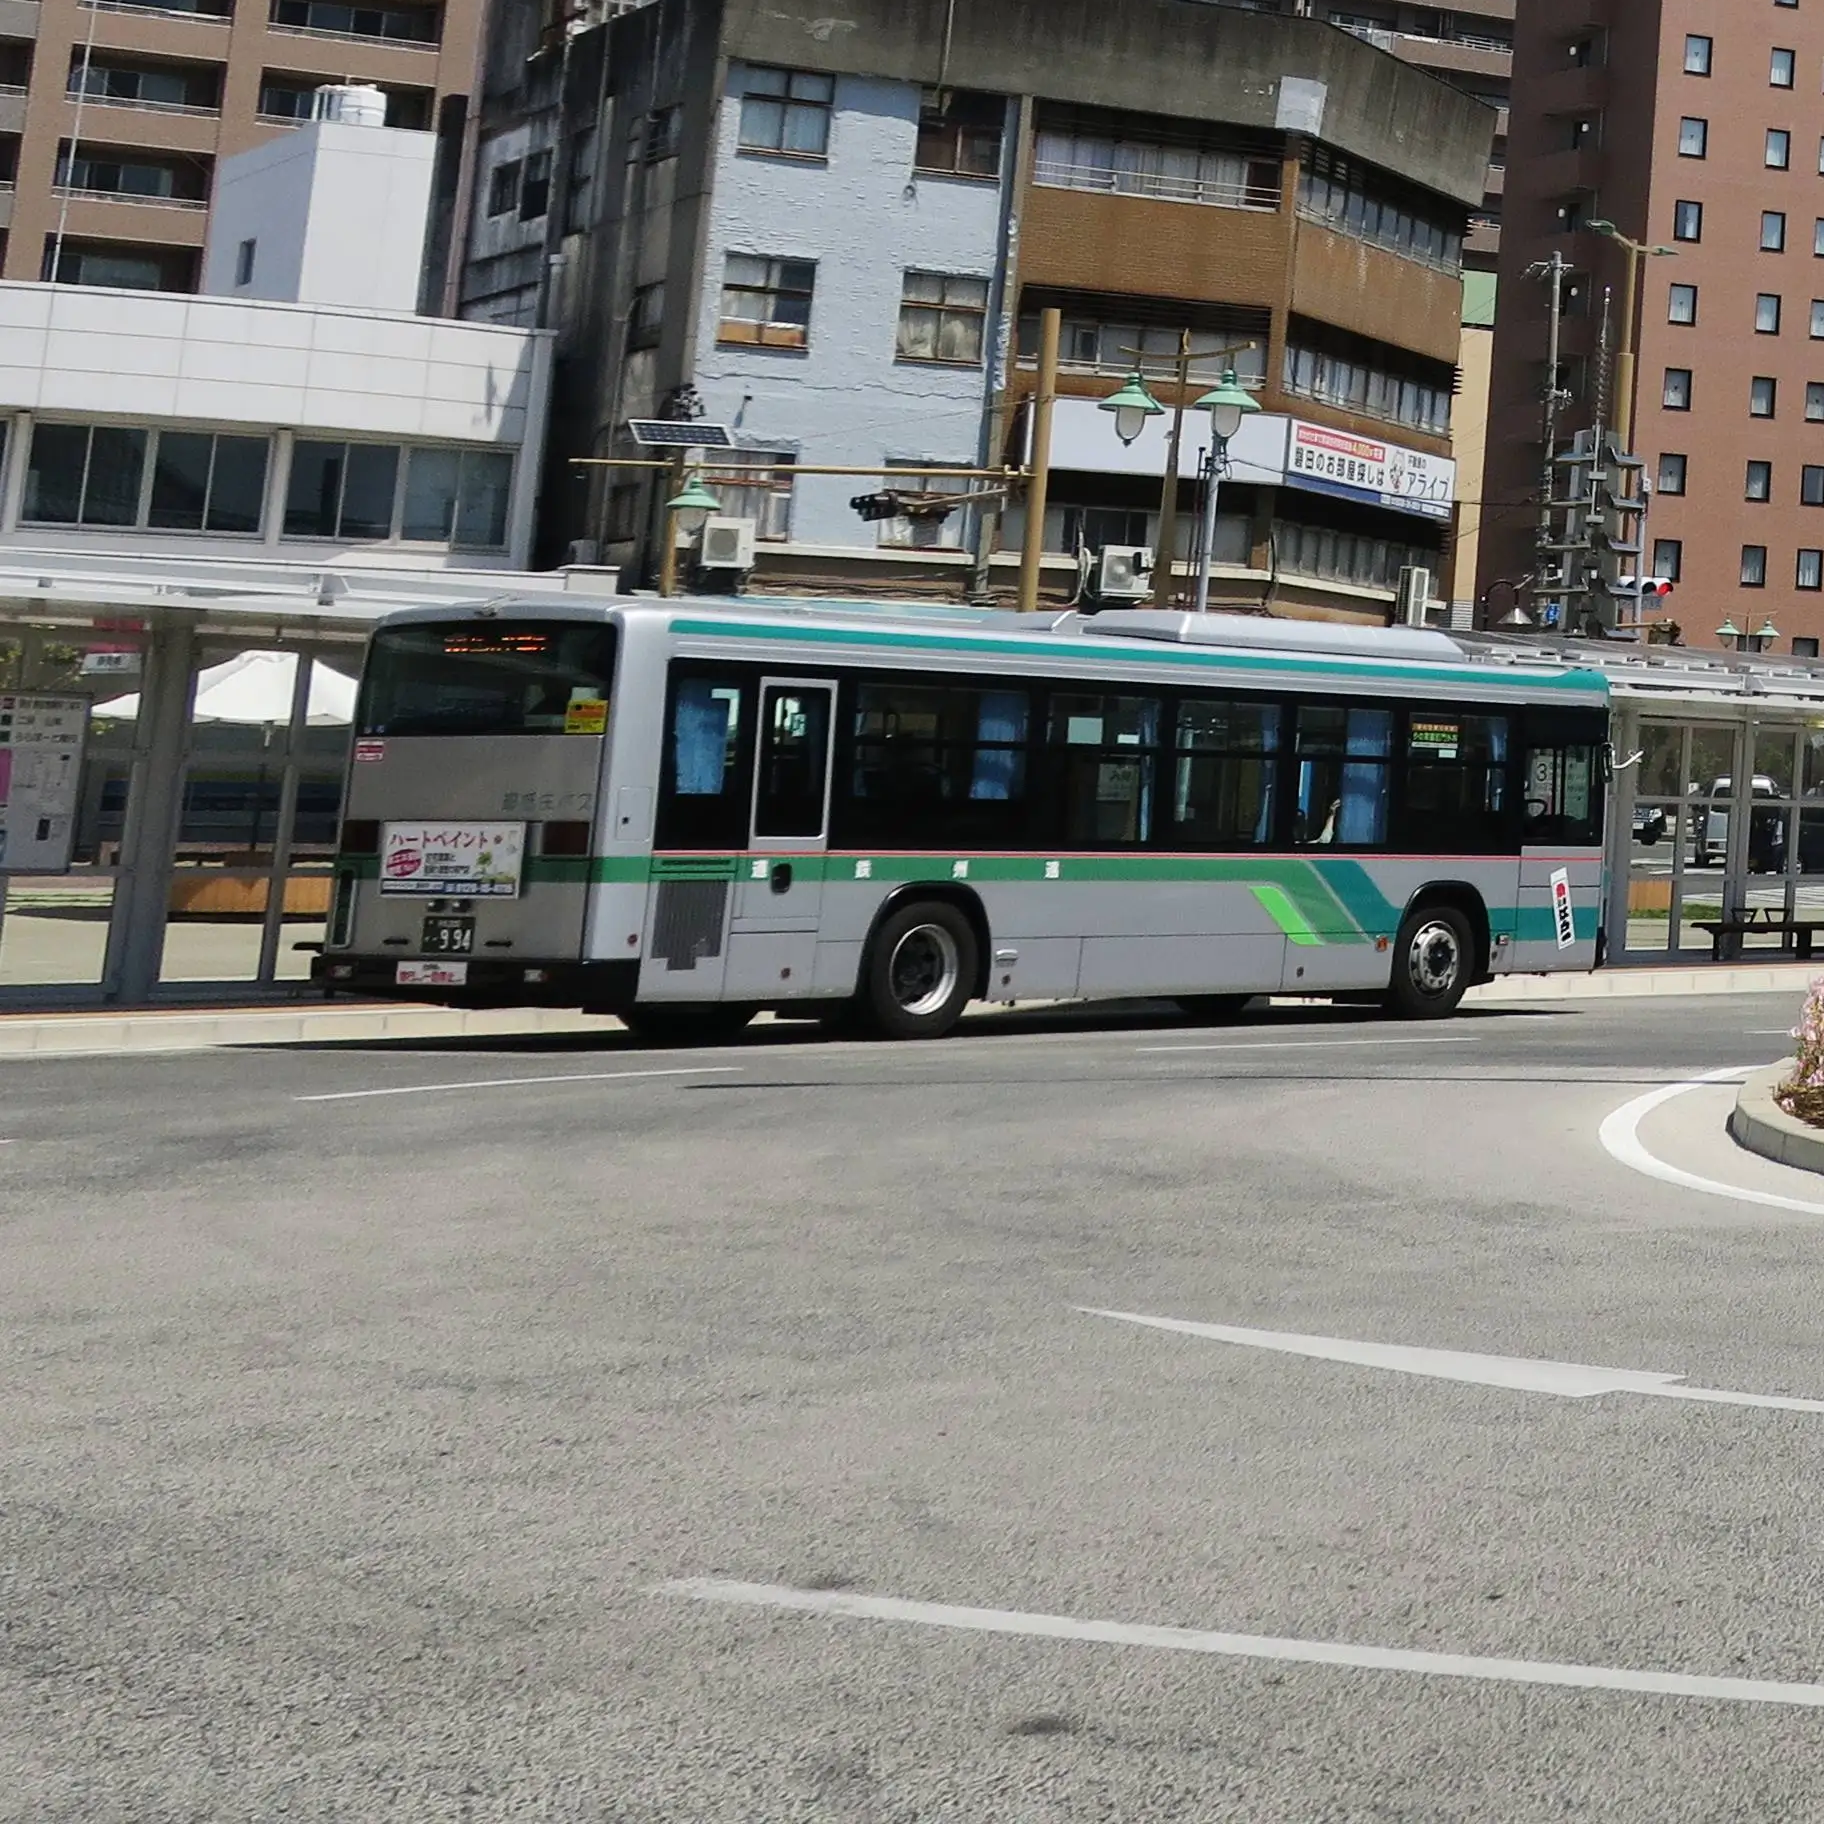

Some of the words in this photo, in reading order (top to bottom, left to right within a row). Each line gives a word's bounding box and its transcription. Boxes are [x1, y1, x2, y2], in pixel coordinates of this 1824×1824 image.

[389, 830, 489, 850] ハートペイント
